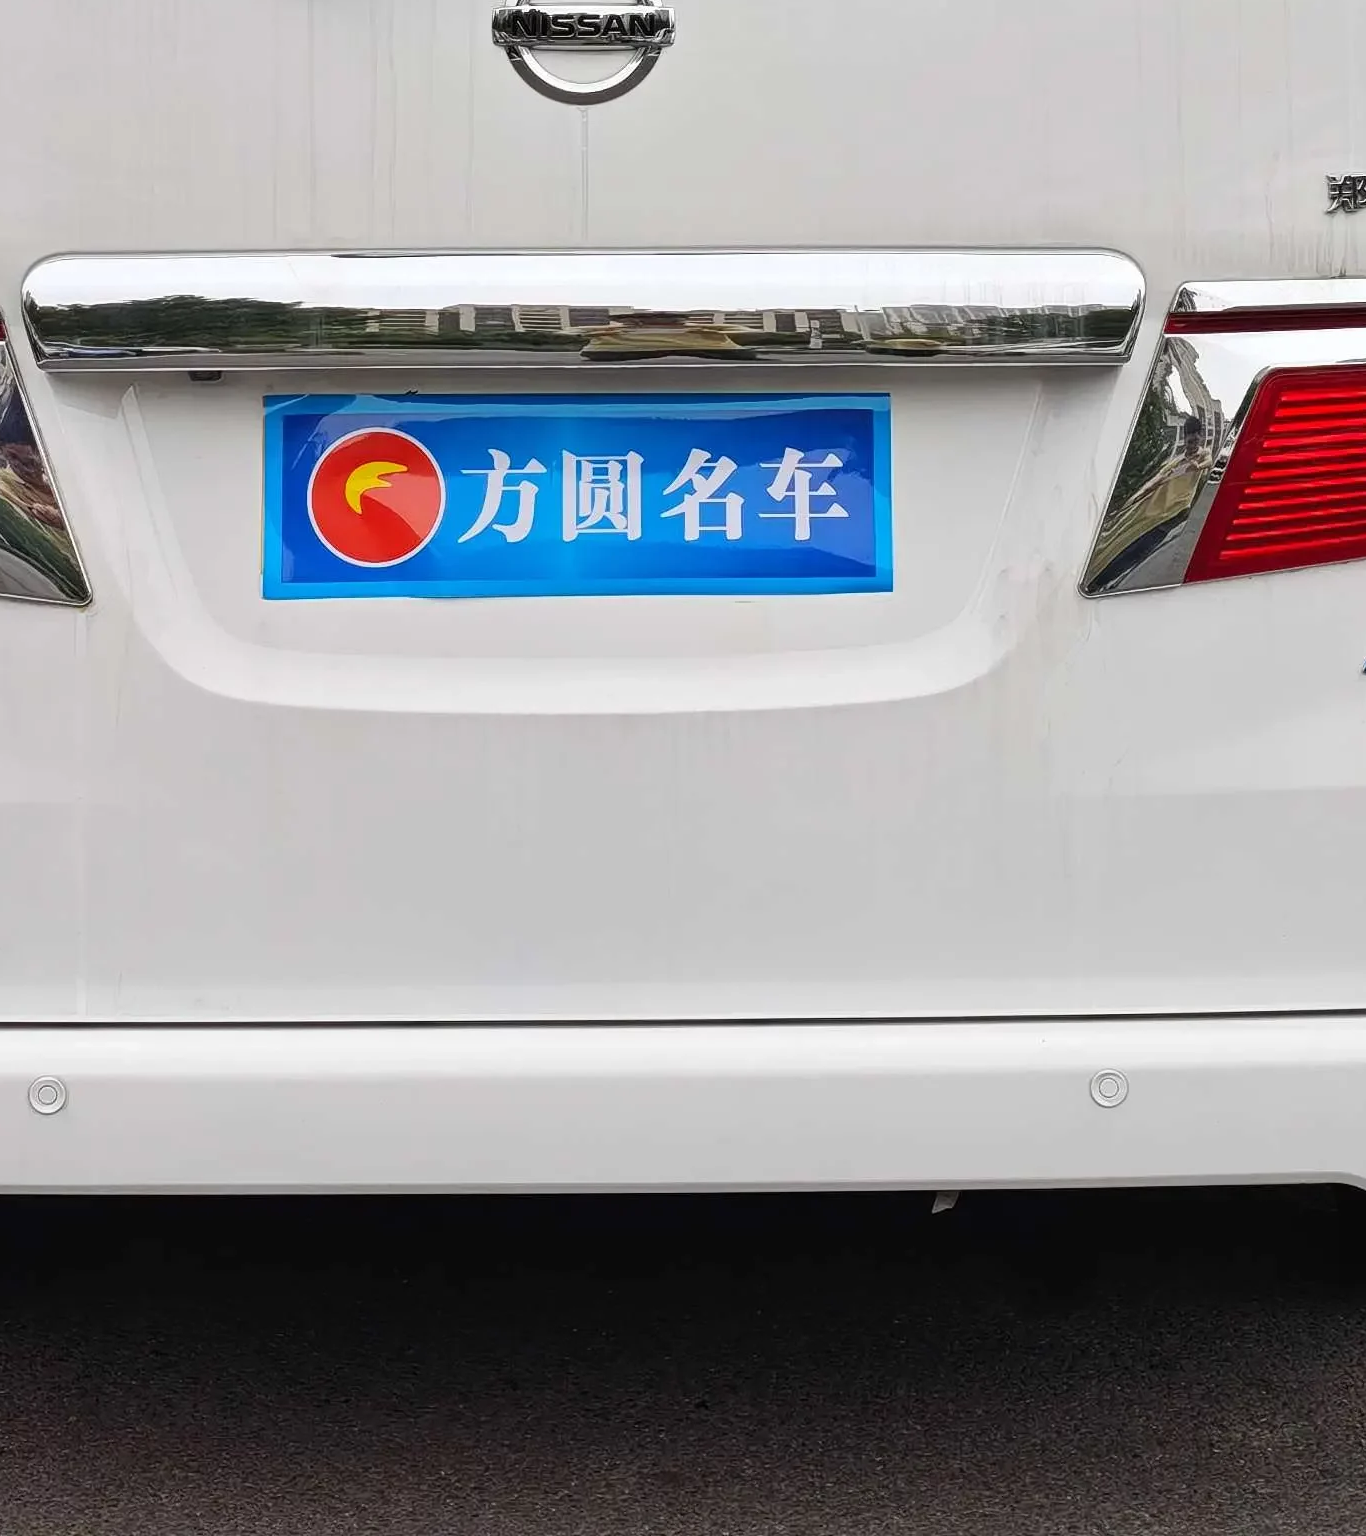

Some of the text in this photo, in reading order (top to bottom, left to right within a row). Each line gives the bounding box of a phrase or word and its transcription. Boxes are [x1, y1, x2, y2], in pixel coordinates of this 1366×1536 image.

[510, 12, 656, 39] NISSAN
[457, 447, 850, 544] 方圆名车
